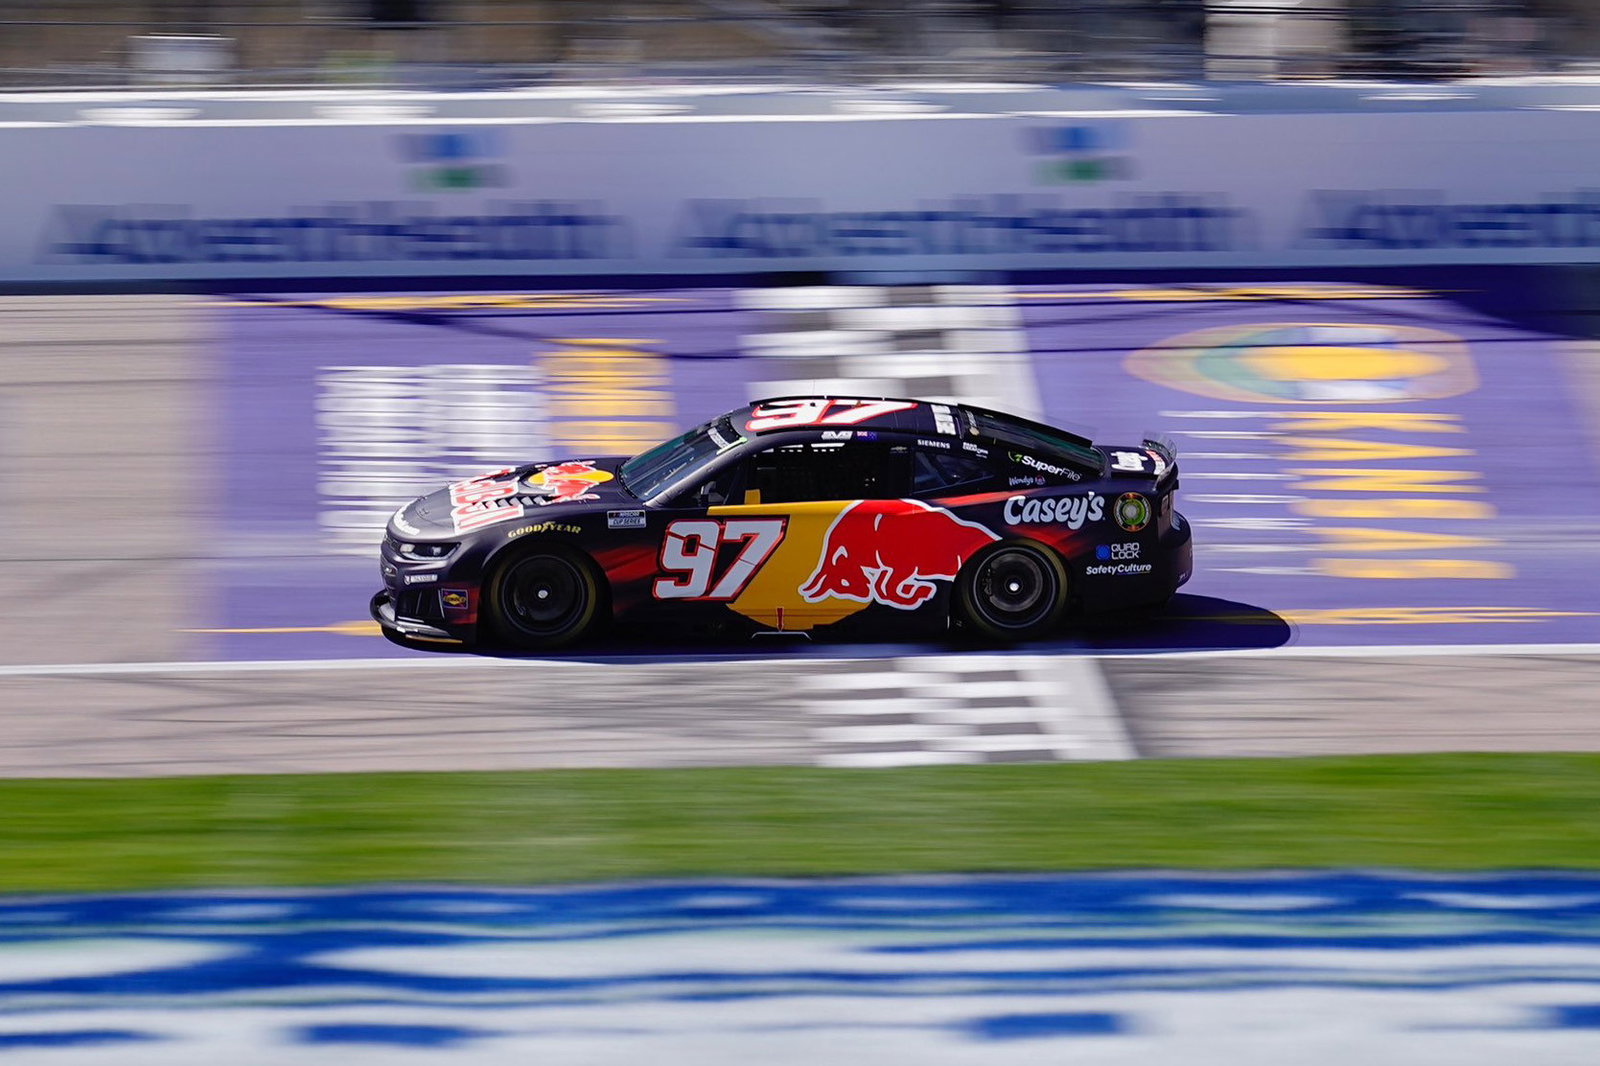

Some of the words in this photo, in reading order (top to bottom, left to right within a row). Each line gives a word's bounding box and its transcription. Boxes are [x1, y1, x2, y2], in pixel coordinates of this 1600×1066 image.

[745, 399, 918, 431] 97
[917, 439, 951, 449] SIEMENS
[1022, 455, 1081, 482] SuperFile
[1004, 492, 1105, 530] Casey's
[507, 521, 582, 539] GOODYEAR
[1111, 542, 1140, 551] QUAD
[1111, 551, 1140, 560] LOCK
[653, 519, 788, 600] 97
[1086, 563, 1152, 575] SafetyCulture
